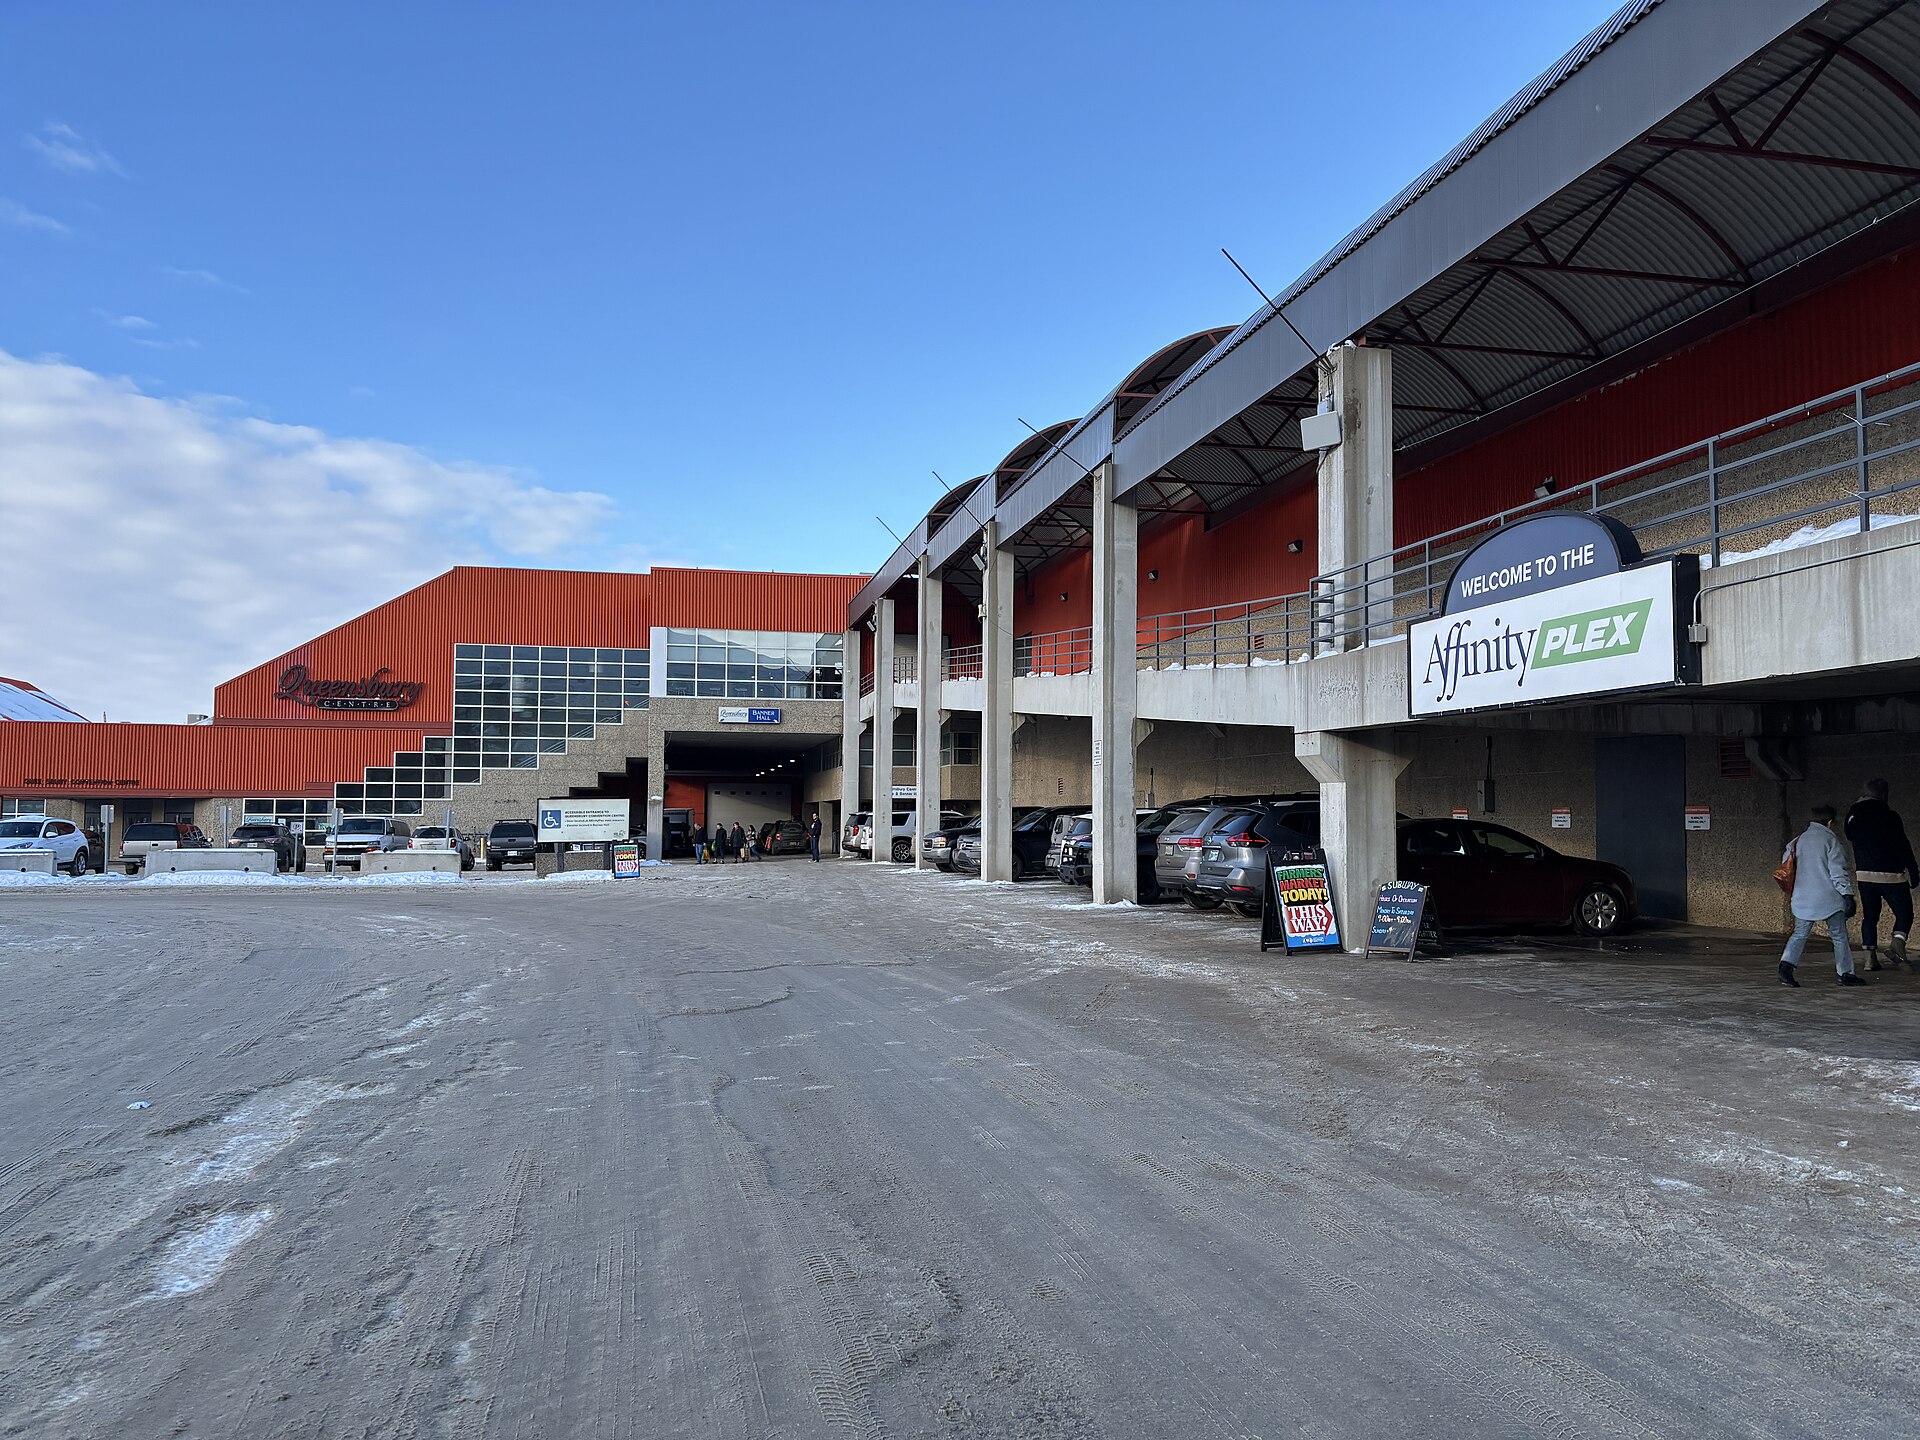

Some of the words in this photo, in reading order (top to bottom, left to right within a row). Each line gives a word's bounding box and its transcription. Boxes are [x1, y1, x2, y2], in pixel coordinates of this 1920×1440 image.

[1461, 563, 1532, 598] WELCOME
[1536, 555, 1557, 576] TO
[1560, 543, 1595, 570] THE
[1423, 617, 1537, 702] Affinity
[1541, 611, 1639, 659] PLEX
[274, 664, 424, 706] Queensbury
[720, 709, 748, 718] Queensbury
[1279, 878, 1326, 891] MARKET
[1387, 880, 1420, 891] SUBWAY
[1281, 888, 1329, 903] TODAY!
[1288, 904, 1325, 920] THIS
[1290, 917, 1328, 932] WAY!
